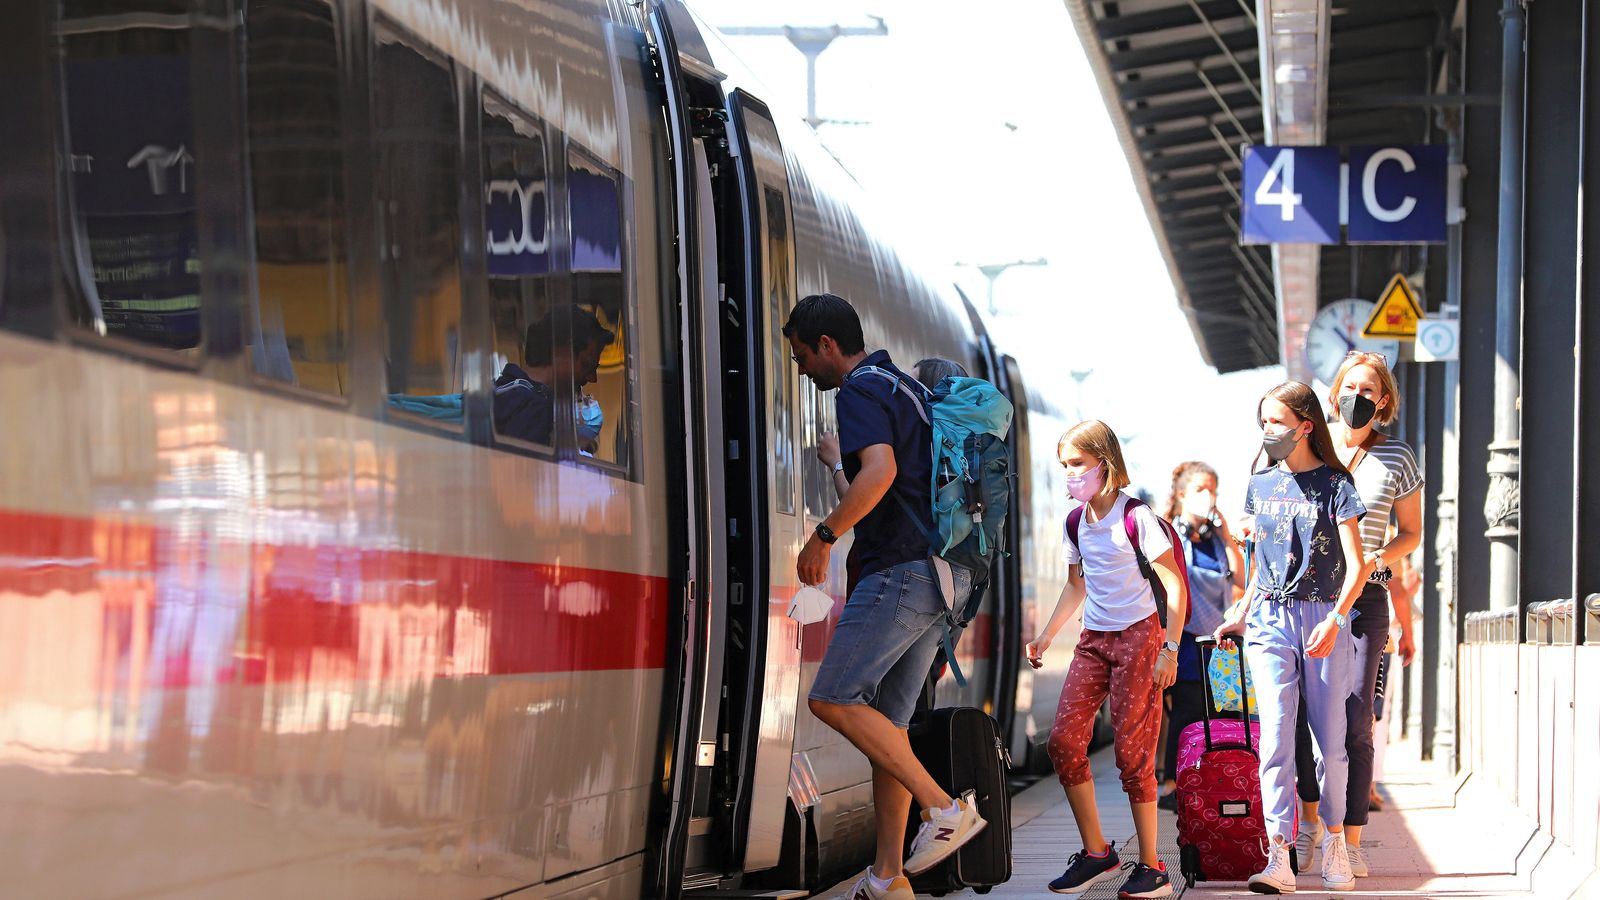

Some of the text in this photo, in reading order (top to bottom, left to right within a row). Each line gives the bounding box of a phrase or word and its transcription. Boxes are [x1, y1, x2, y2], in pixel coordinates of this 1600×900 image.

[1254, 148, 1302, 221] 4
[1362, 148, 1417, 222] C
[1254, 500, 1318, 519] NEW YORK
[934, 827, 954, 841] N
